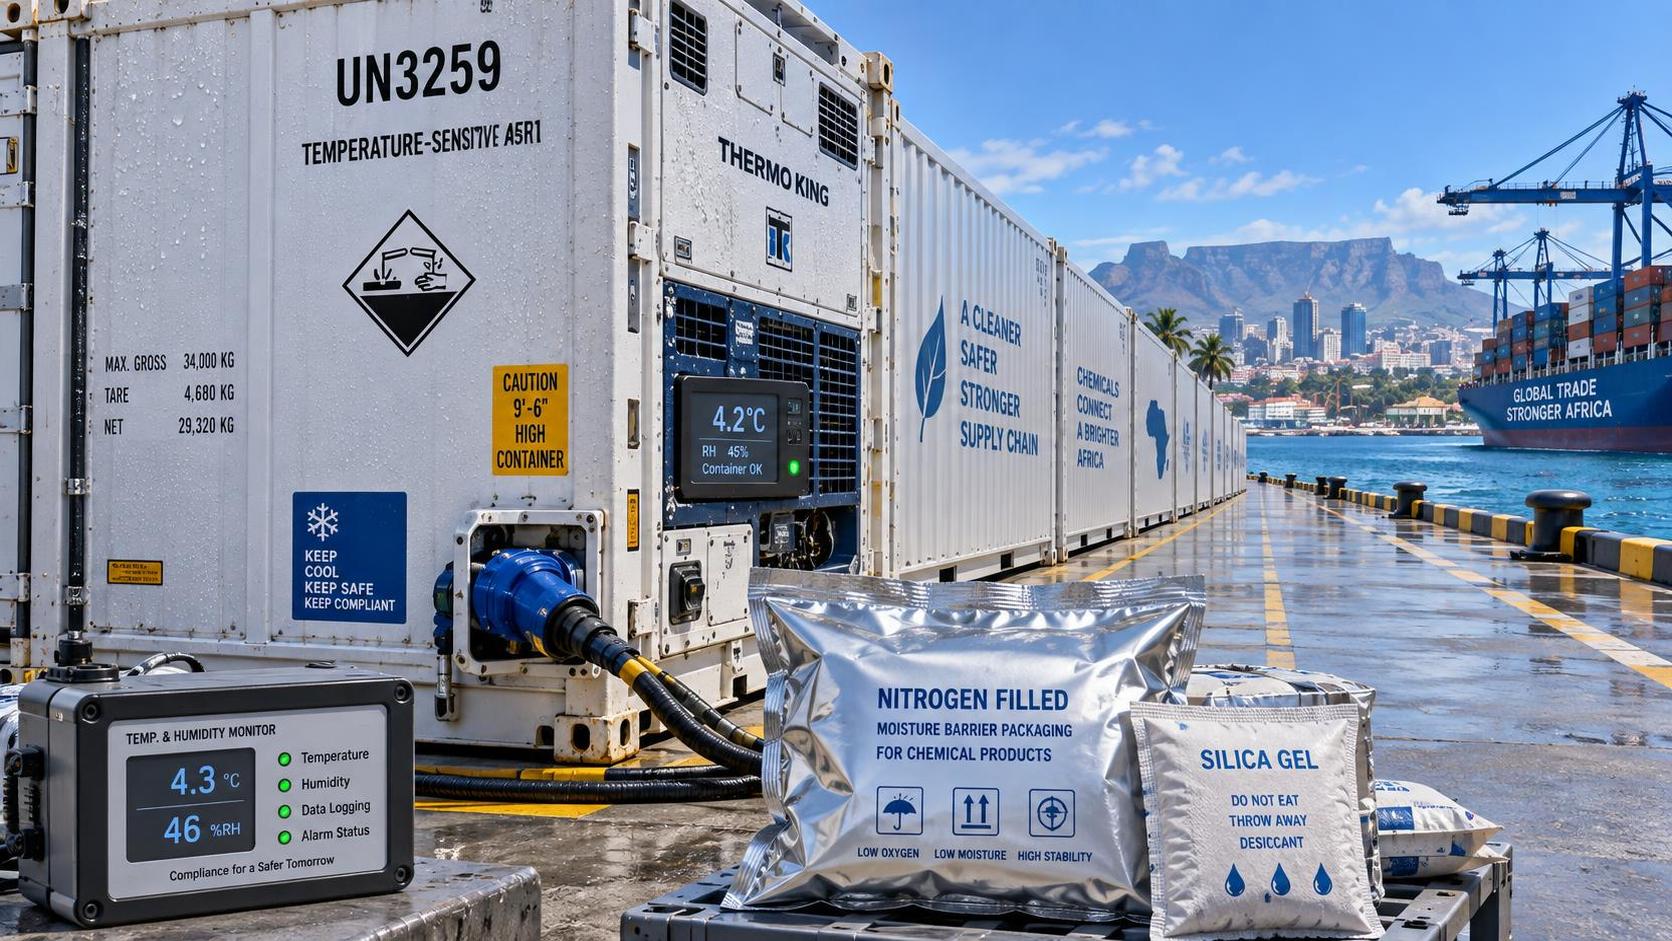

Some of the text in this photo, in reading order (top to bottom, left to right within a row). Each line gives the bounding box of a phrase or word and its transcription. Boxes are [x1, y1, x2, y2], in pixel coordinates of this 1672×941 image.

[337, 40, 502, 106] UN3259
[718, 136, 828, 206] THERMO KING
[961, 300, 1021, 347] A CLEANER
[105, 352, 234, 372] MAX. GROSS 34,000 KG
[961, 341, 997, 375] SAFER
[503, 372, 558, 392] CAUTION
[1077, 366, 1119, 398] CHEMICALS
[1514, 379, 1597, 402] GLOBAL TRADE
[105, 384, 234, 404] TARE 4,680 KG
[961, 381, 1020, 418] STRONGER
[1077, 394, 1112, 421] CONNECT
[1507, 400, 1612, 421] STRONGER AFRICA
[104, 417, 234, 435] NET 29,320 KG
[515, 424, 545, 444] HIGH
[1077, 422, 1119, 447] A BRIGHTER
[961, 421, 1038, 456] SUPPLY CHAIN
[496, 450, 564, 470] CONTAINER
[703, 445, 749, 458] RH 45%
[1077, 449, 1104, 469] AFRICA
[702, 462, 762, 476] Container OK
[304, 550, 337, 562] KEEP
[304, 564, 340, 578] COOL
[304, 582, 374, 595] KEEP SAFE
[304, 597, 396, 612] KEEP COMPLIANT
[878, 688, 1069, 711] NITROGEN FILLED
[127, 724, 276, 745] TEMP. & HUMIDITY MONITOR
[877, 723, 1072, 737] MOISTURE BARRIER PACKAGING
[302, 749, 369, 765] Temperature
[877, 746, 1051, 762] FOR CHEMICAL PRODUCTS
[1200, 749, 1319, 770] SILICA GEL
[171, 765, 216, 796] 4.3
[302, 776, 351, 792] Humidity
[302, 800, 371, 817] Data Logging
[1231, 794, 1299, 807] DO NOT EAT
[164, 815, 241, 844] 46 %RH
[1229, 814, 1307, 827] THROW AWAY
[302, 825, 370, 842] Alarm Status
[1240, 836, 1304, 849] DESICCANT
[858, 847, 919, 858] LOW OXYGEN
[935, 849, 1006, 860] LOW MOISTURE
[1018, 850, 1092, 862] HIGH STABILITY
[169, 856, 335, 884] Compliance for a Safer Tomorrow
